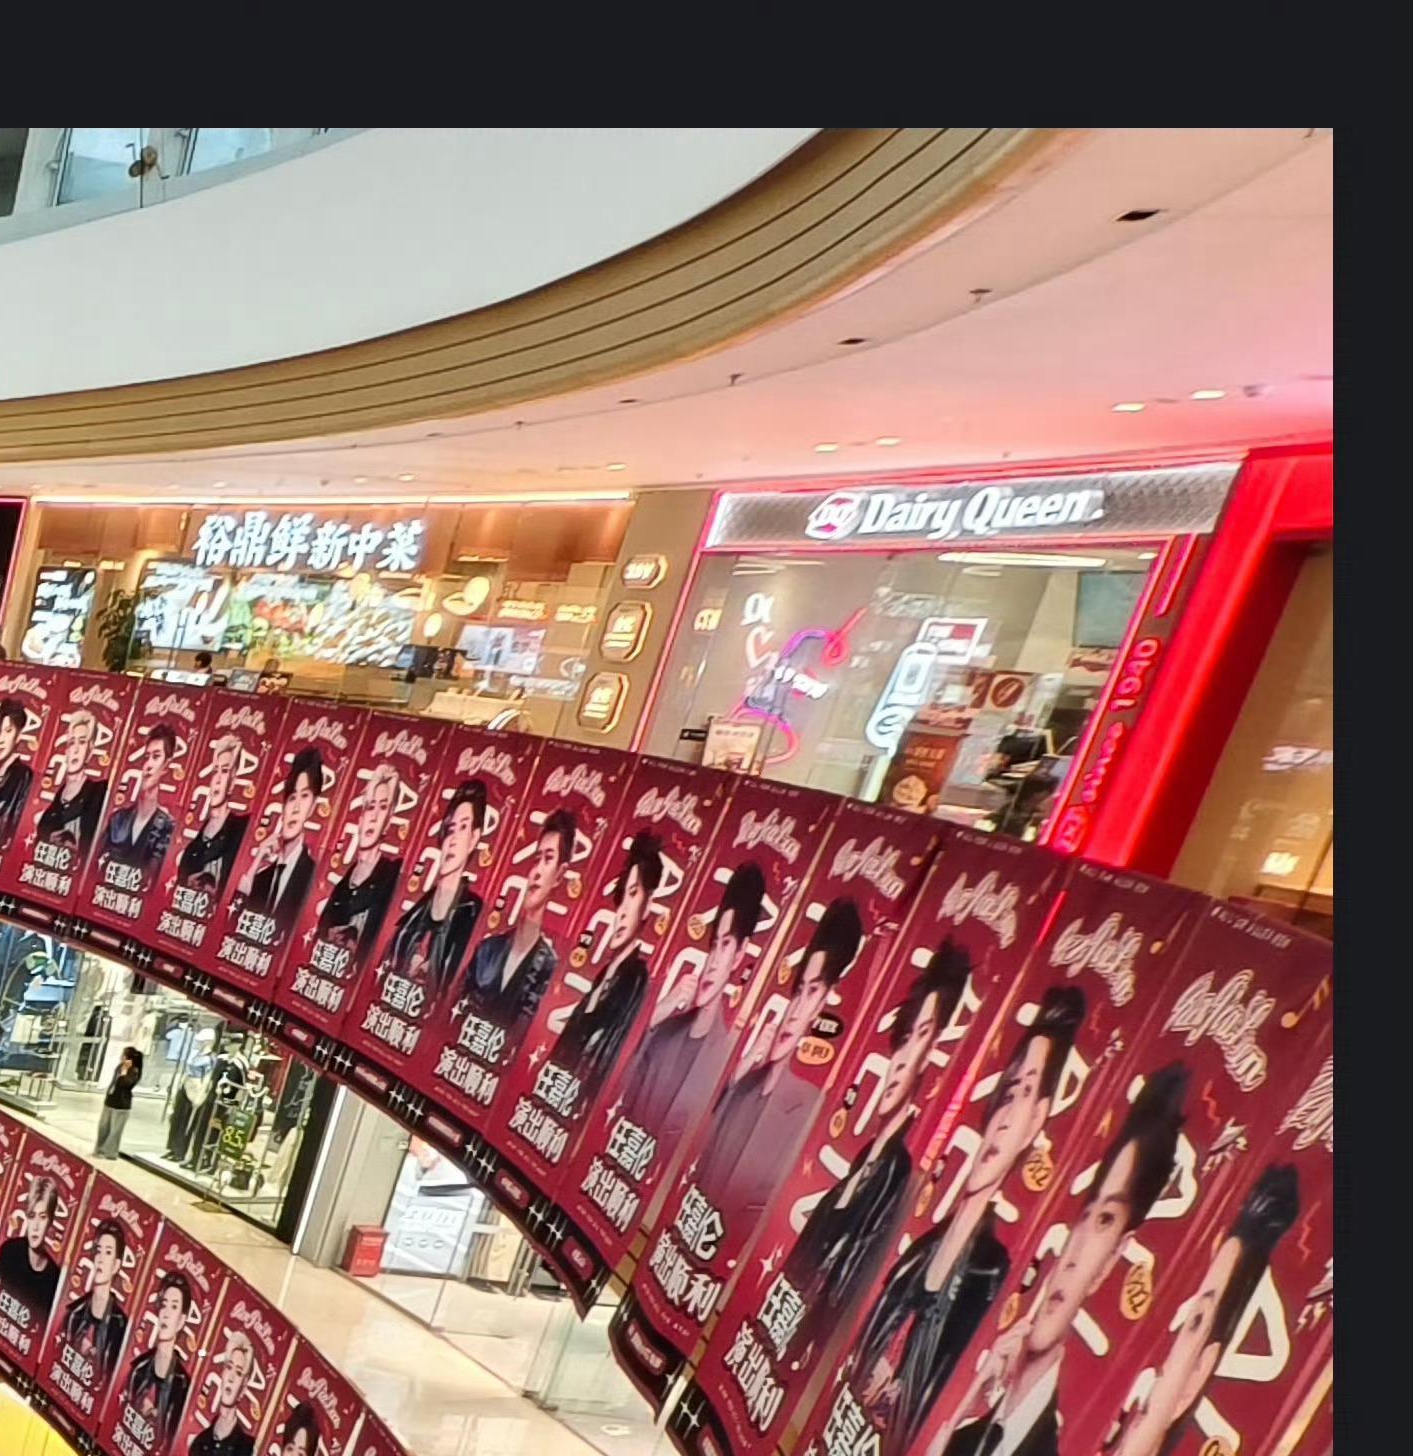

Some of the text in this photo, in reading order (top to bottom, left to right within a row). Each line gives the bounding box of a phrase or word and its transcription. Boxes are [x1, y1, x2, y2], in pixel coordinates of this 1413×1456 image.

[857, 492, 967, 541] Dairy
[172, 885, 211, 919] 任嘉伦
[158, 910, 207, 948] 演出顺利
[380, 973, 426, 1018] 任嘉伦
[360, 1003, 419, 1055] 演出顺利
[534, 1061, 583, 1110] 任嘉伦
[507, 1098, 571, 1166] 演出顺利
[677, 1185, 726, 1260] 任嘉伦
[647, 1231, 721, 1324] 演出顺利
[123, 1405, 155, 1455] 任嘉伦
